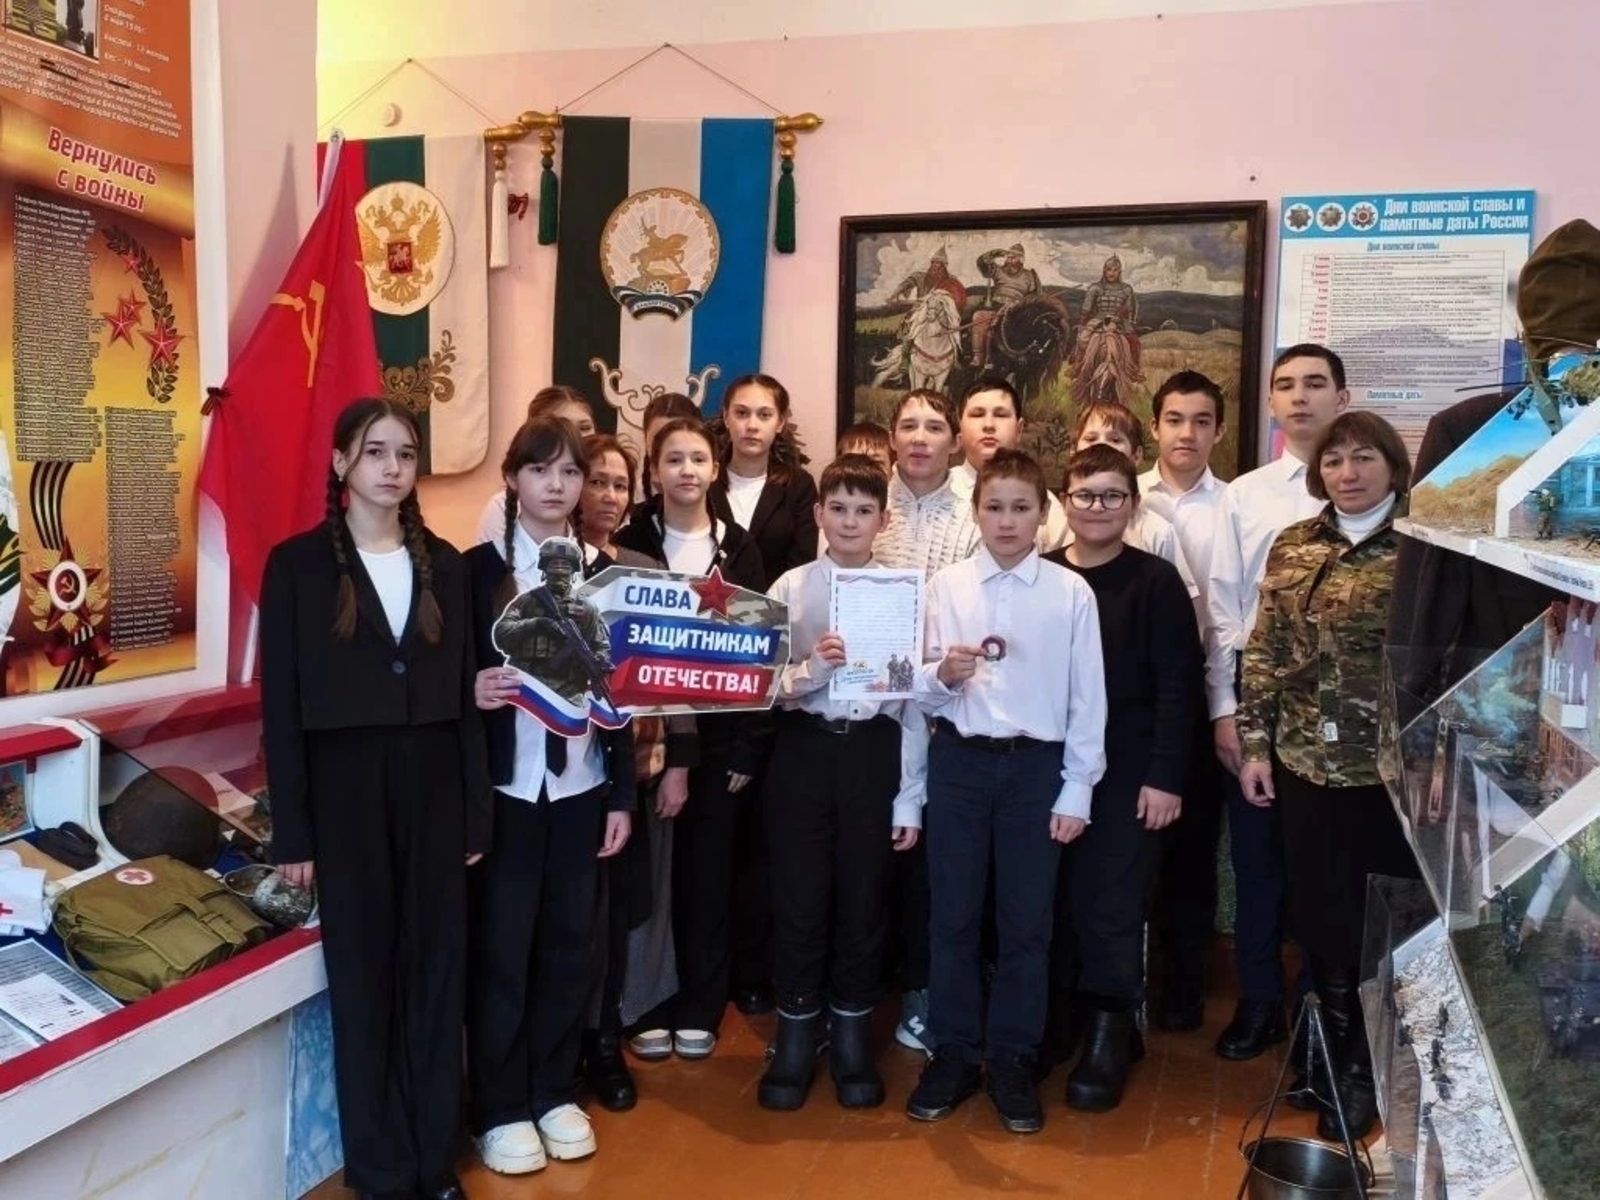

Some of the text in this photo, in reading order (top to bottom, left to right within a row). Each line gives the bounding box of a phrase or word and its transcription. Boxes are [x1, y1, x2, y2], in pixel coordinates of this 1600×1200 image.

[48, 128, 157, 185] Вернулись
[57, 169, 144, 211] с войны
[1384, 199, 1409, 215] Дни
[1411, 196, 1470, 214] воинской
[1473, 197, 1512, 211] славы
[1380, 214, 1529, 232] памятные даты России
[624, 585, 692, 609] СЛАВА
[627, 623, 770, 656] ЗАЩИТНИКАМ
[638, 665, 760, 694] ОТЕЧЕСТВА!
